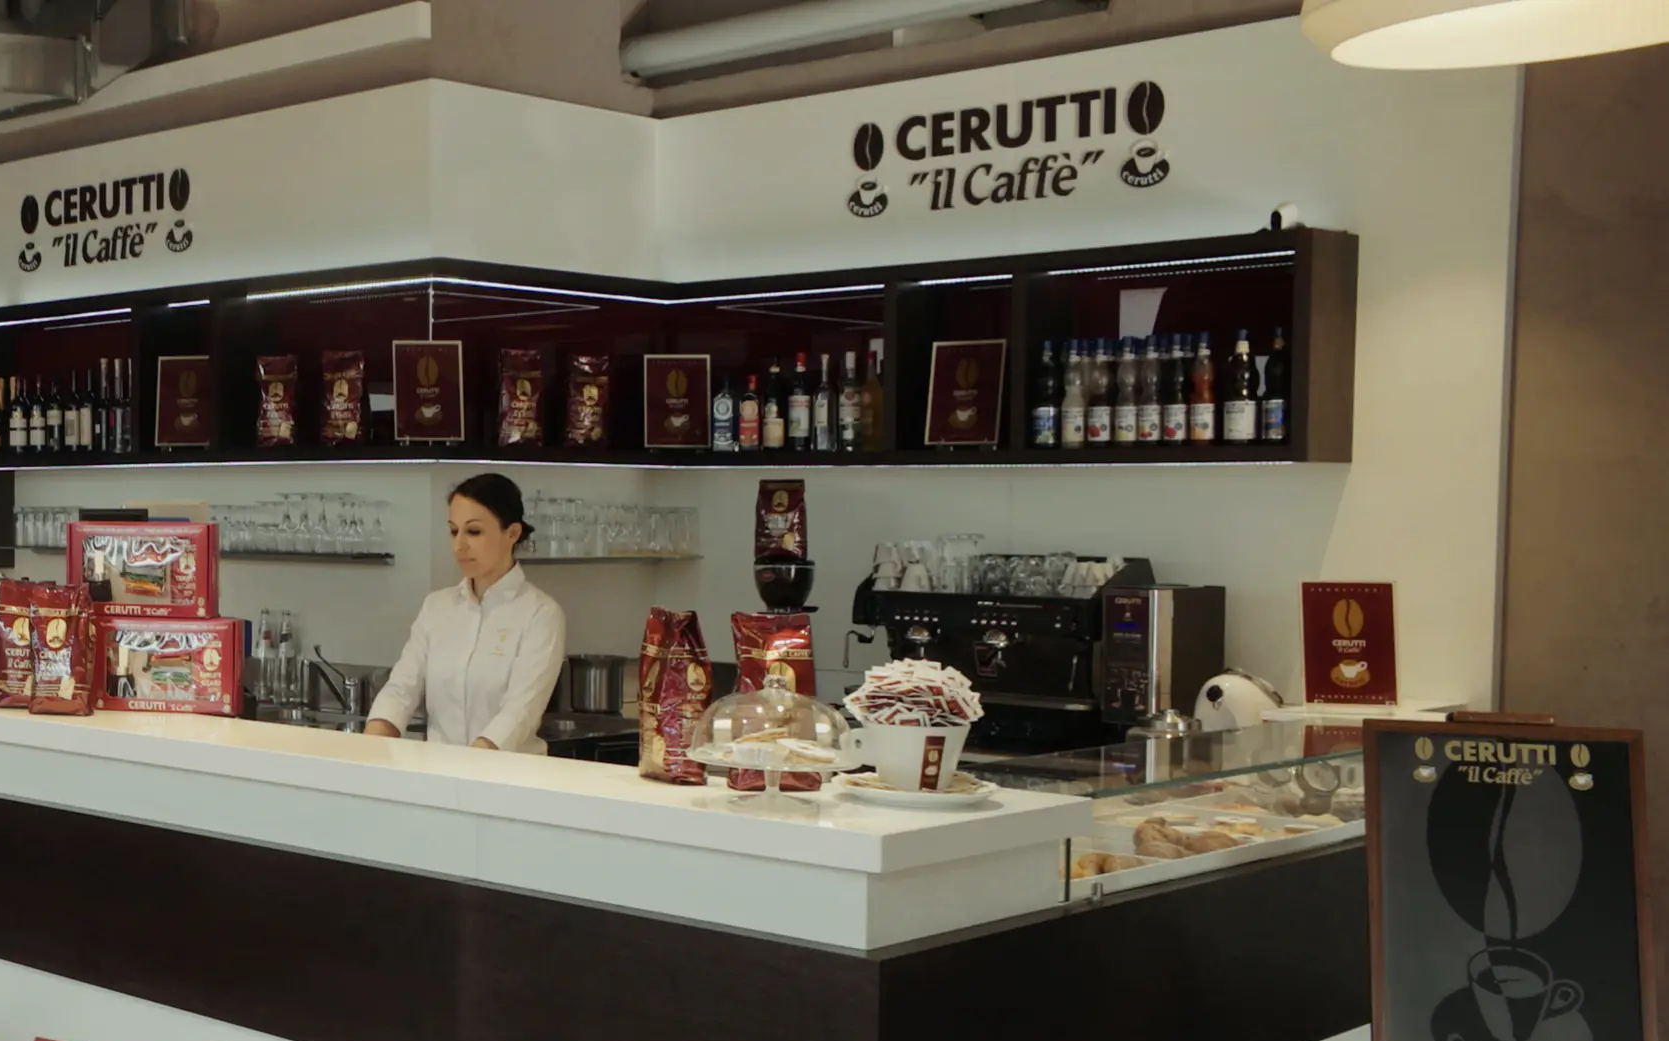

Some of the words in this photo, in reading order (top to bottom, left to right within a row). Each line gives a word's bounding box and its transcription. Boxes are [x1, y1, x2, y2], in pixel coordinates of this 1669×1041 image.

[896, 87, 1117, 161] CERUTTI
[908, 167, 956, 211] "il
[963, 150, 1105, 206] Caffè"
[44, 172, 165, 227] CERUTTI
[52, 233, 78, 267] "il
[82, 222, 158, 264] Caffè"
[104, 605, 141, 615] CERUTTI
[5, 648, 30, 657] CERUT
[1332, 639, 1366, 648] CERUTTI
[128, 700, 166, 711] CERUTTI
[1444, 739, 1557, 766] CERUTTI
